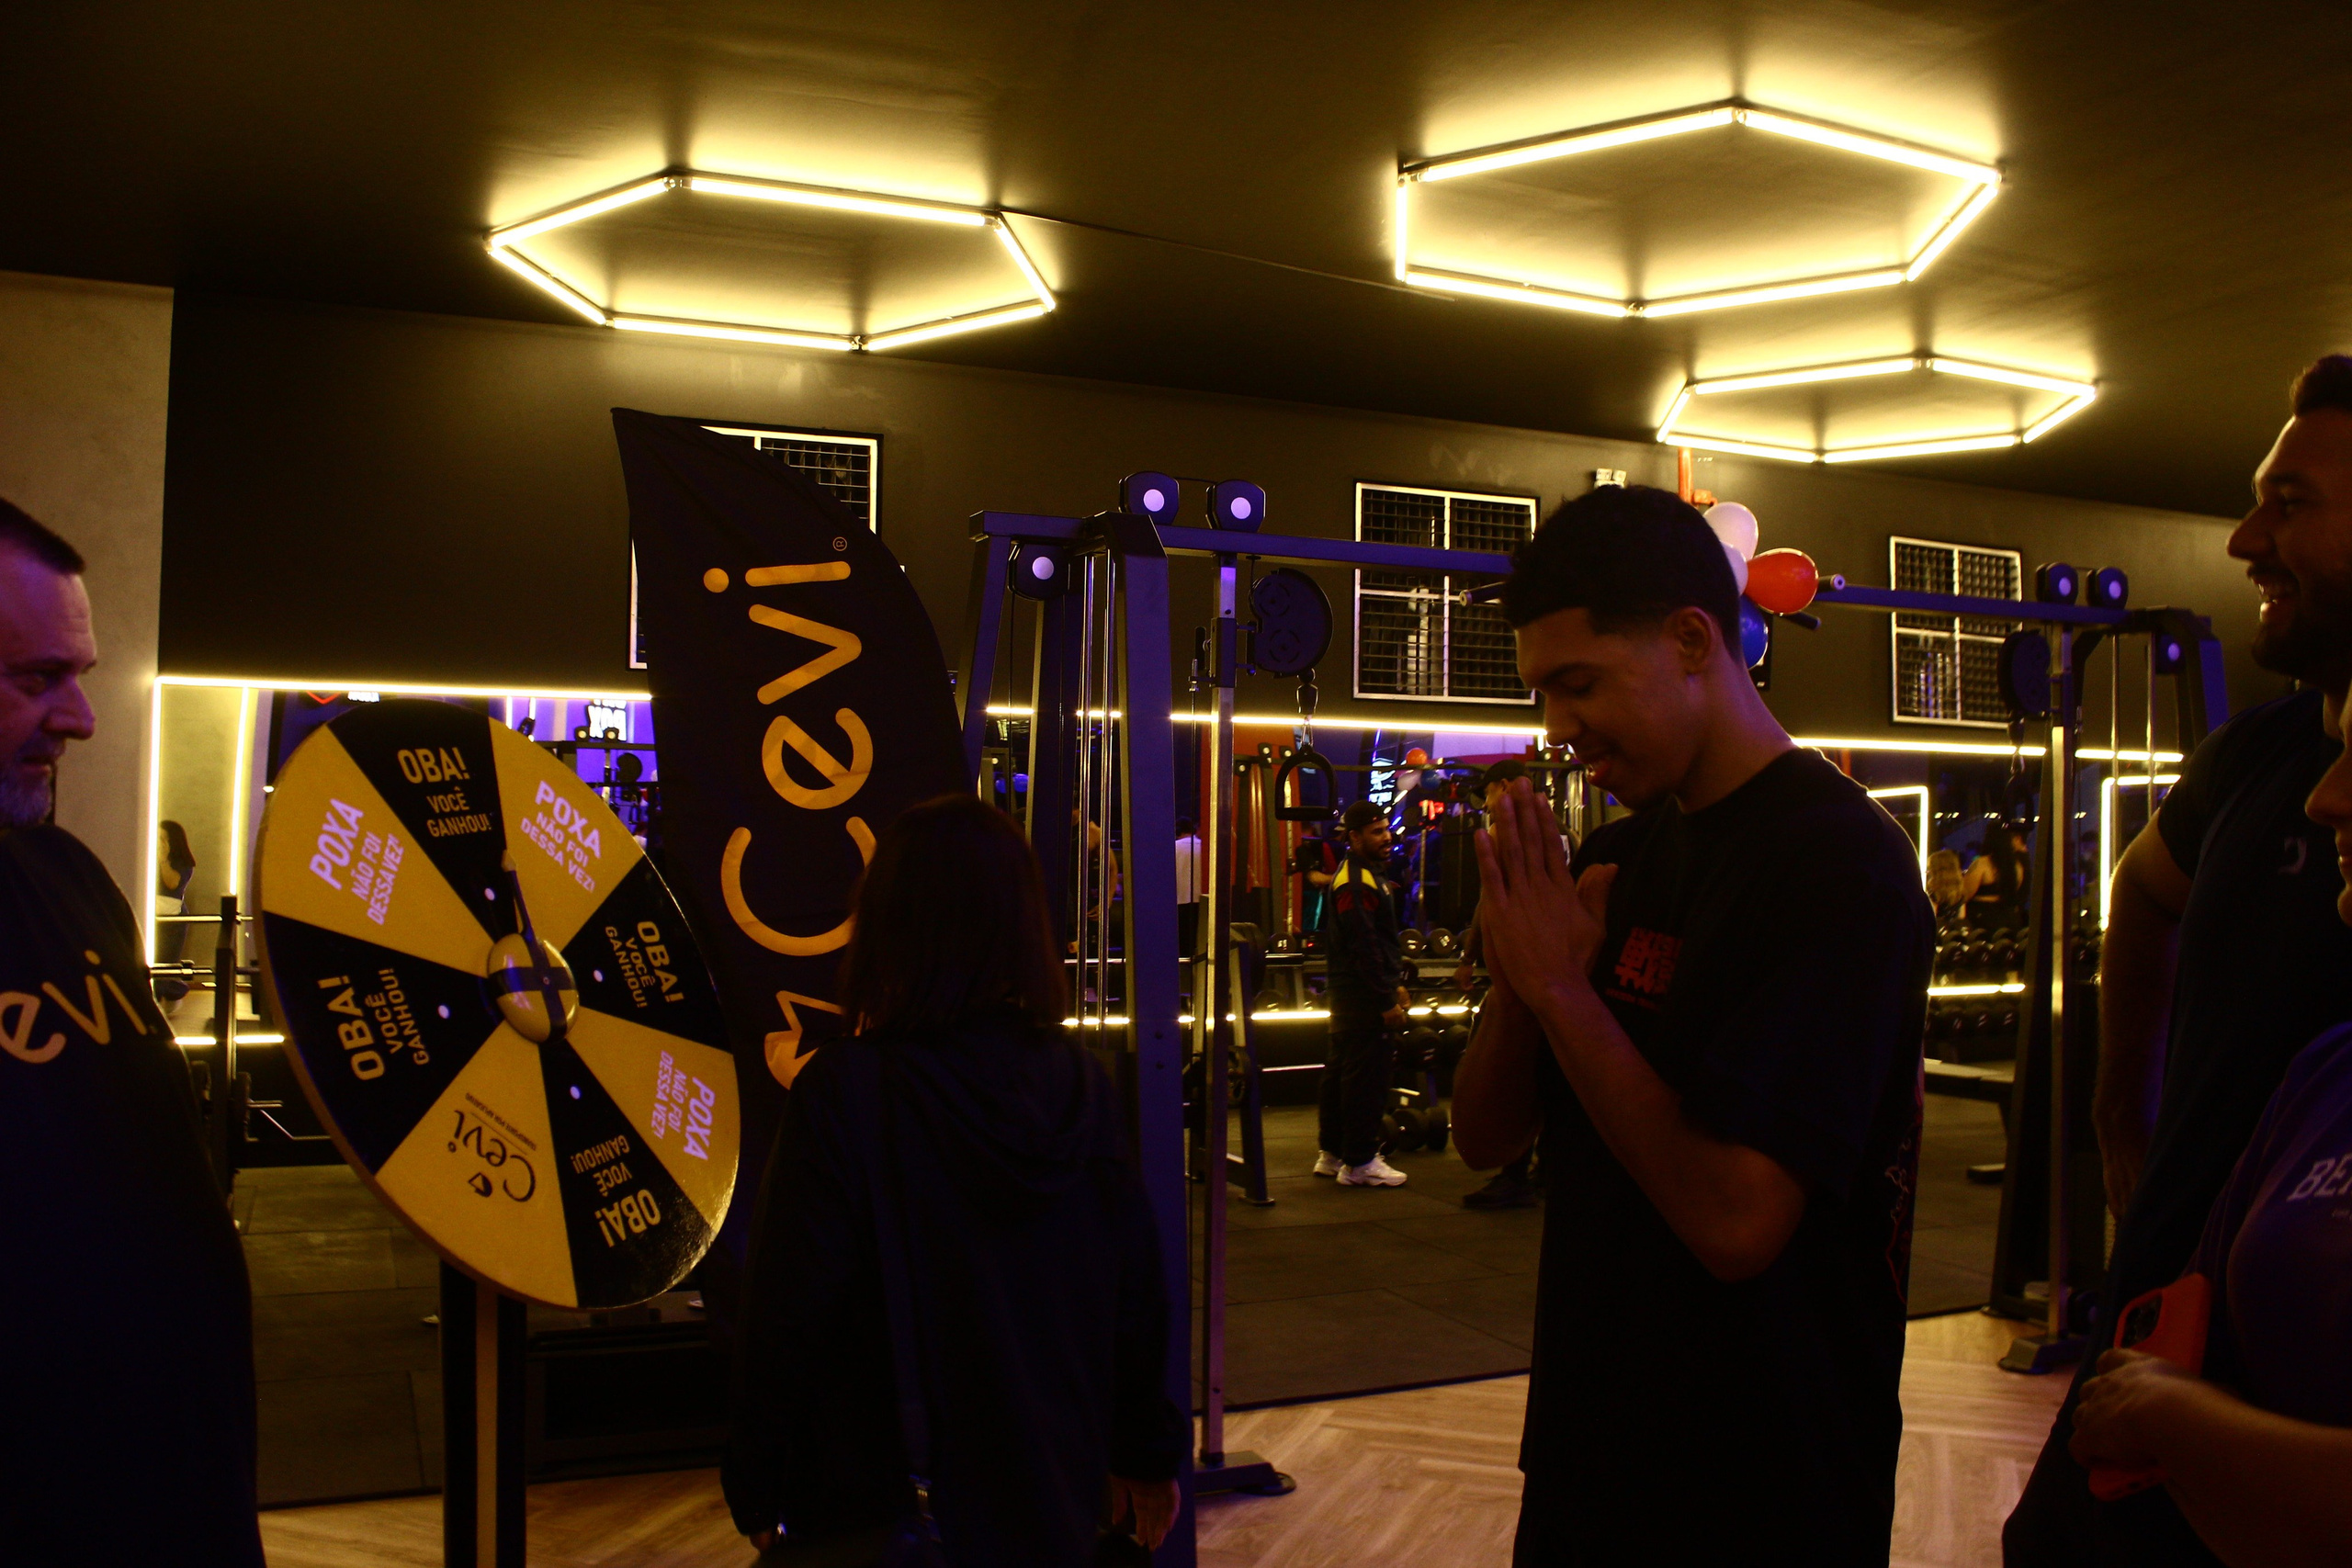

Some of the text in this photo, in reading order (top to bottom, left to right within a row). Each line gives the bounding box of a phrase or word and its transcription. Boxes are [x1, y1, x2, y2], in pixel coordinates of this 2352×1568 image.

[397, 747, 470, 784] OBA!
[703, 560, 876, 956] Cevi
[426, 785, 470, 814] VOCÊ
[426, 813, 492, 838] GANHOU!
[535, 780, 602, 859] POXA
[309, 797, 365, 891] POXA
[350, 830, 382, 902] NÃO FOI
[520, 817, 565, 867] DESSA
[536, 811, 589, 867] NÃO FOI
[367, 833, 404, 926] DESSA VEZ!
[605, 926, 649, 1008] GANHOU!
[626, 937, 656, 987] VOCÊ
[637, 920, 684, 1003] OBA!
[317, 975, 386, 1081] OBA!
[365, 993, 403, 1055] VOCÊ
[378, 968, 430, 1066] GANHOU!
[656, 1049, 674, 1101] DESSA
[668, 1068, 689, 1134] NÃO FOI
[684, 1076, 716, 1161] POXA
[448, 1110, 536, 1201] Cevi
[570, 1134, 630, 1174] GANHOU!
[593, 1162, 632, 1197] VOCÊ
[594, 1189, 661, 1248] OBA!
